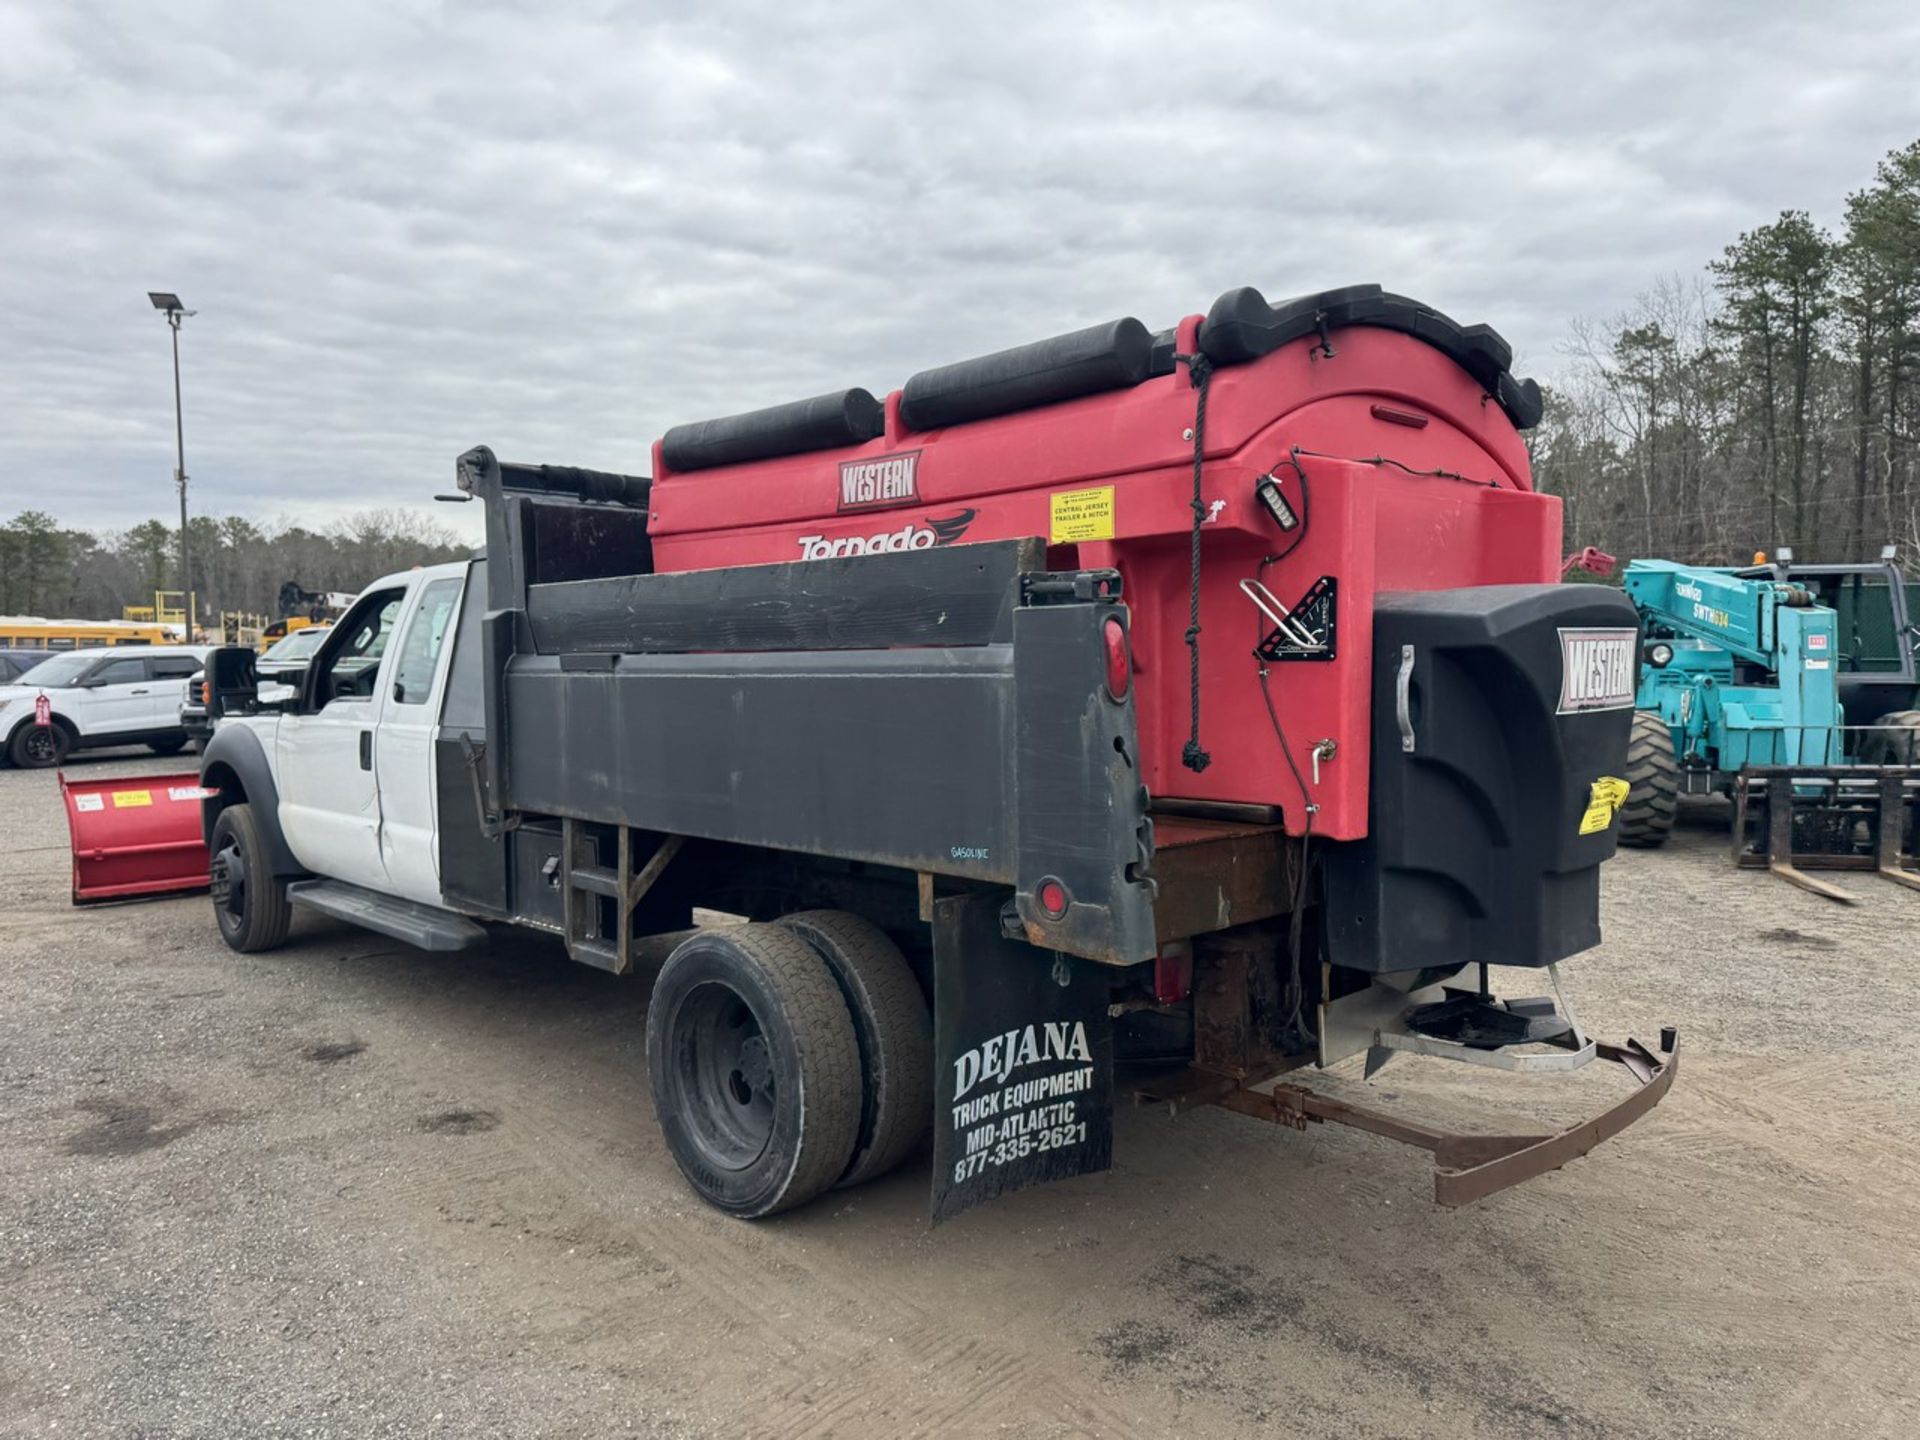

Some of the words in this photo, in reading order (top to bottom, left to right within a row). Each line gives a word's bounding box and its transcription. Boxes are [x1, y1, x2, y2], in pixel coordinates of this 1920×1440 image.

[843, 458, 914, 504] WESTERN
[1055, 506, 1082, 514] CENTRAL
[1084, 503, 1109, 511] JERSEY
[1055, 513, 1081, 522] TRAILER
[798, 524, 936, 562] Tornado
[1568, 639, 1633, 700] WESTERN
[950, 846, 990, 860] GASOLINE
[952, 1021, 1094, 1102] DEJANA
[952, 1090, 1001, 1131] TRUCK
[1003, 1067, 1094, 1110] EQUIPMENT
[954, 1121, 1087, 1183] 877-335-2621
[966, 1101, 1076, 1155] MID-ATLANTIC
